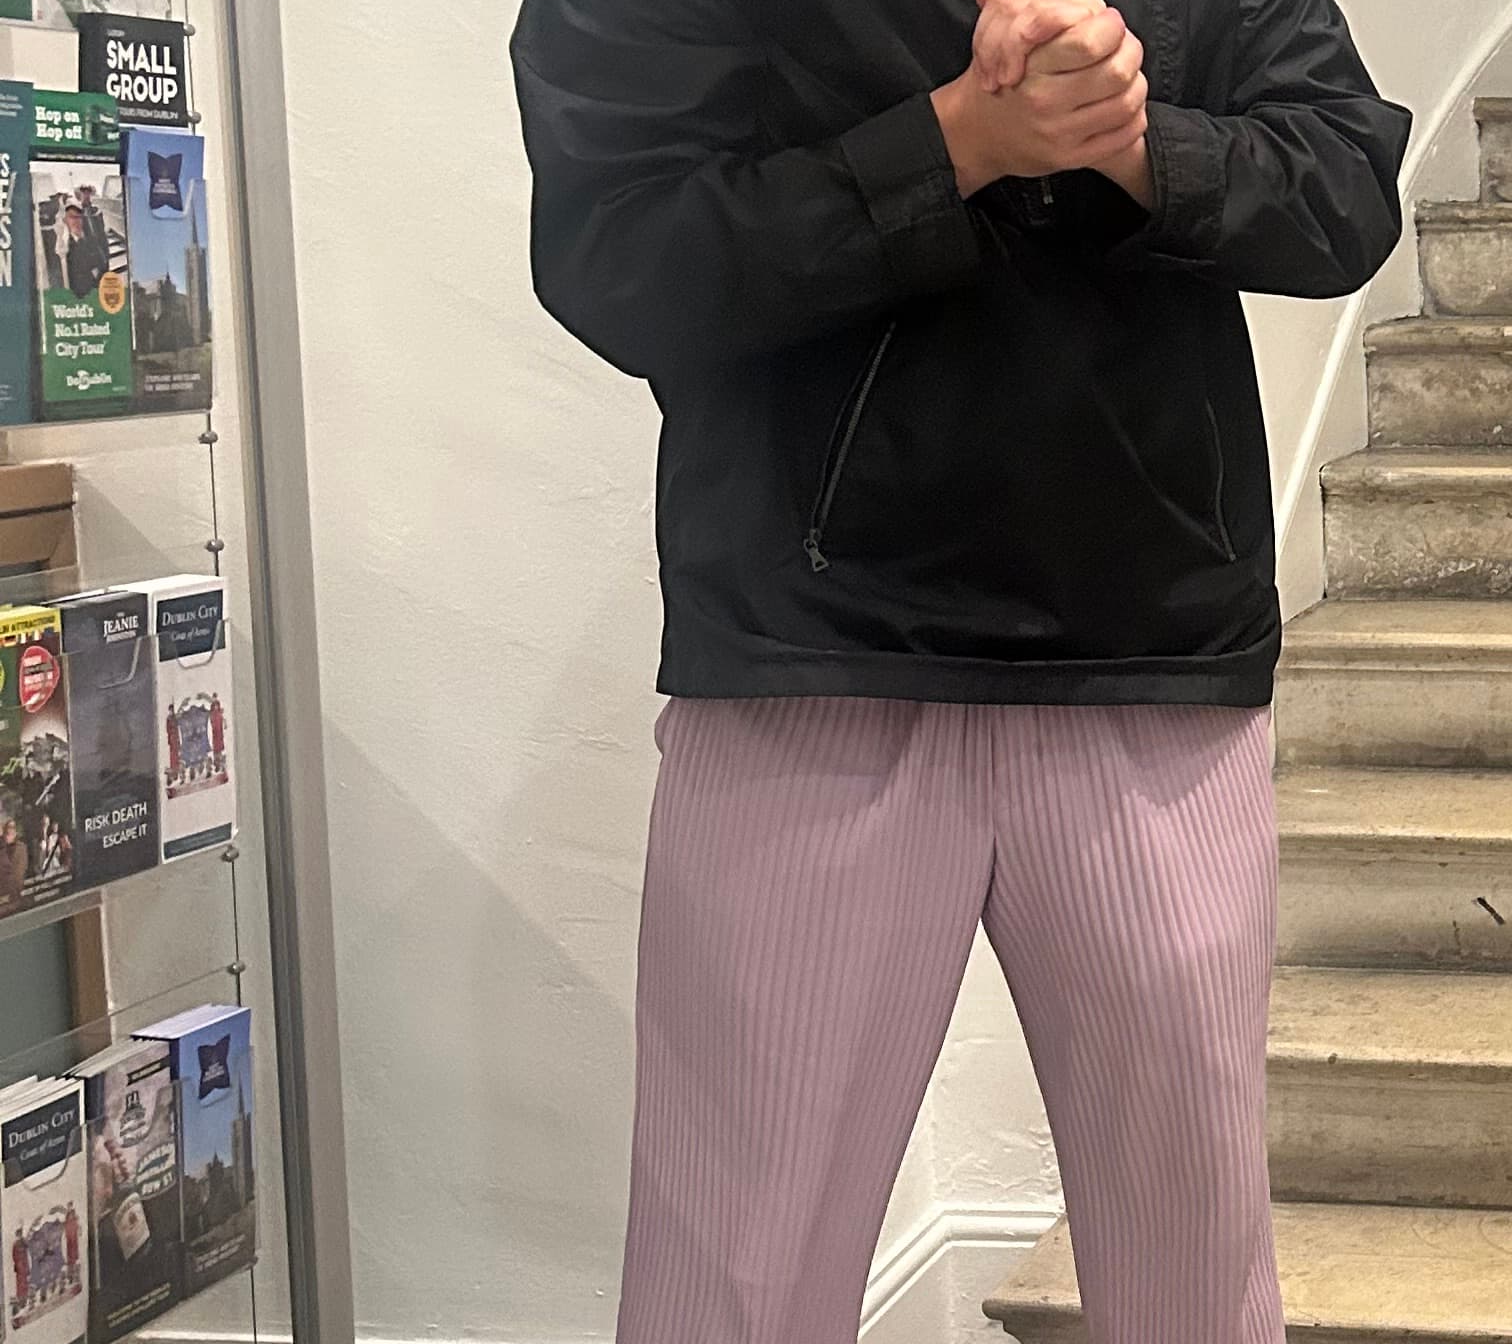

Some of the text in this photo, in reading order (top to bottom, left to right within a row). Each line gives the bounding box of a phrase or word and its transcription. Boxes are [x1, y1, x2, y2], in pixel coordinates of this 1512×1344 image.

[106, 39, 177, 75] SMALL
[106, 72, 178, 105] GROUP
[35, 106, 80, 125] Hop on
[36, 123, 82, 142] Hop off
[51, 304, 94, 318] World's
[54, 323, 79, 338] No.1
[55, 342, 79, 359] City
[103, 615, 139, 638] JEANIE
[84, 801, 148, 832] RISK DEATH
[102, 823, 148, 849] ESCAPE IT
